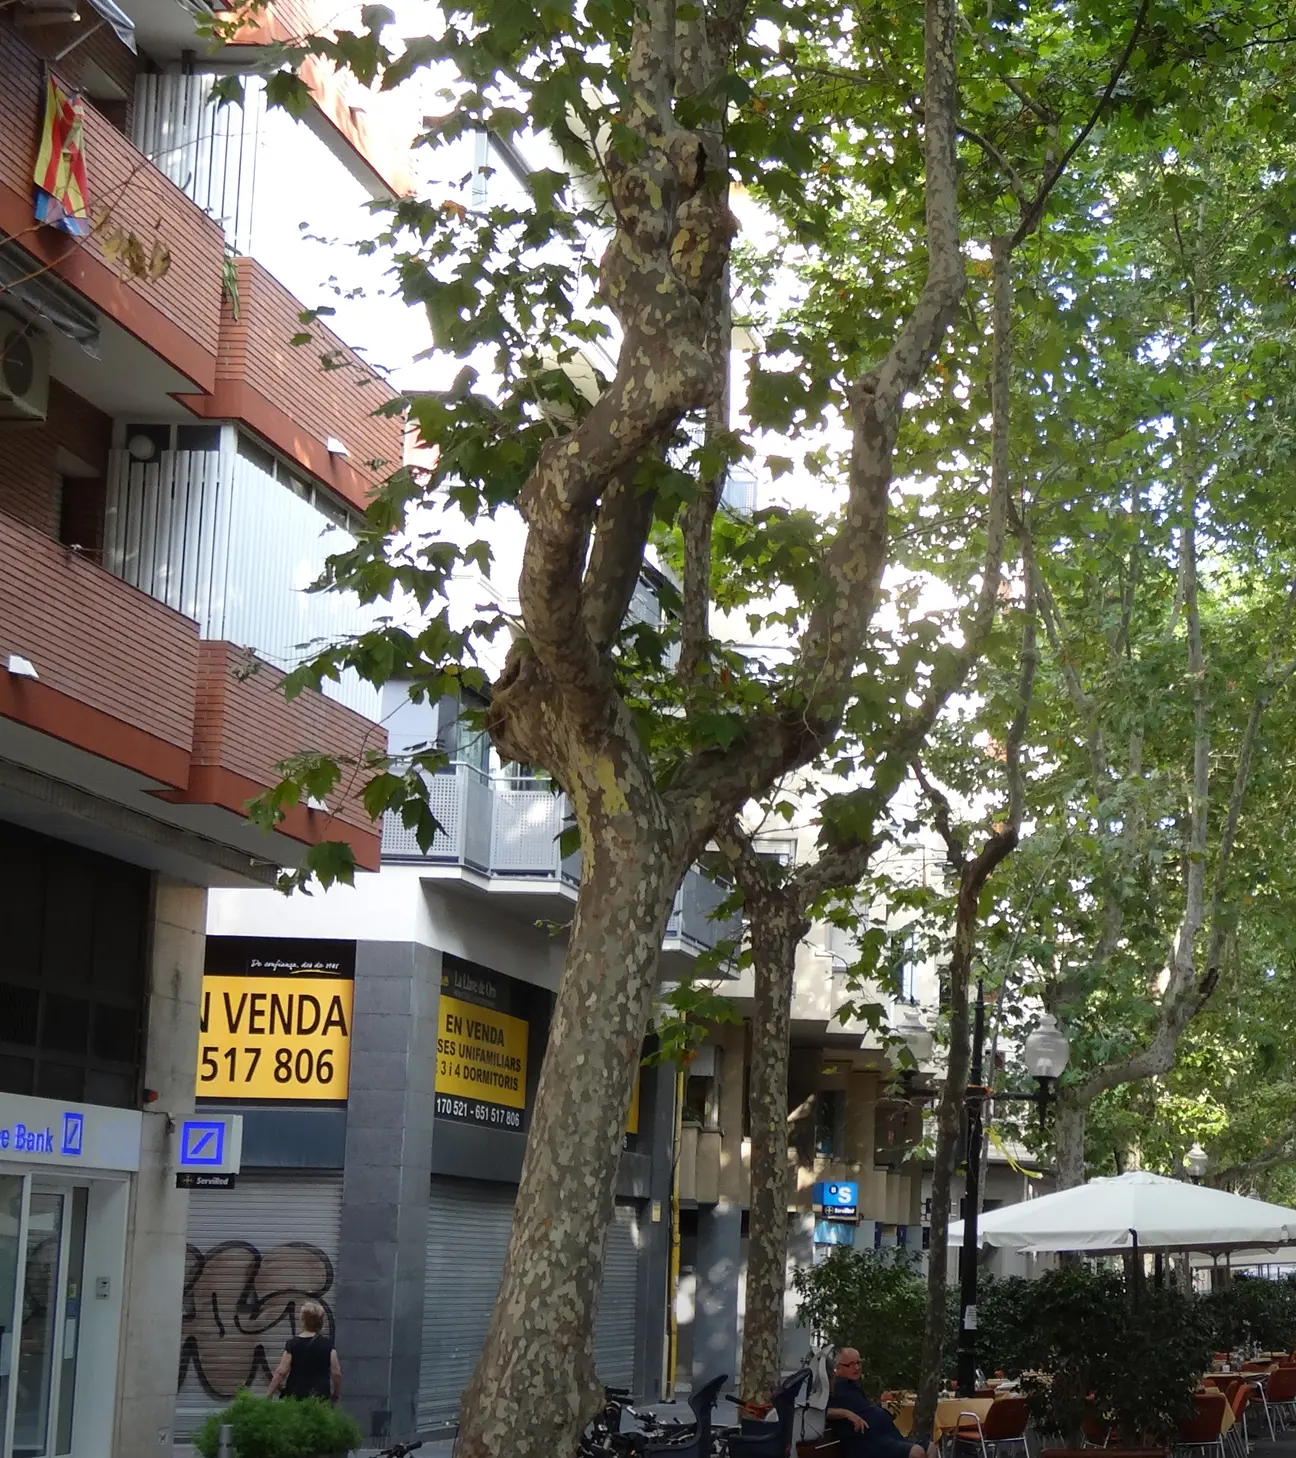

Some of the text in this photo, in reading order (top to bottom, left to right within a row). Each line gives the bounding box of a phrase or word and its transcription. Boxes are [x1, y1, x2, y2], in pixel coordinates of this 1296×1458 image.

[223, 992, 349, 1037] VENDA
[446, 1014, 505, 1047] EN VENDA
[200, 1046, 334, 1084] 517 806
[437, 1038, 521, 1073] SES UNIFAMILIARS
[441, 1060, 447, 1076] 3
[454, 1063, 461, 1078] 4
[463, 1065, 519, 1091] DORMITORIS
[436, 1098, 452, 1114] 170
[453, 1100, 468, 1117] 521
[475, 1105, 489, 1121] 651
[490, 1107, 505, 1123] 517
[505, 1111, 520, 1127] 806
[15, 1124, 53, 1153] Bank
[195, 1176, 229, 1186] ServiRed
